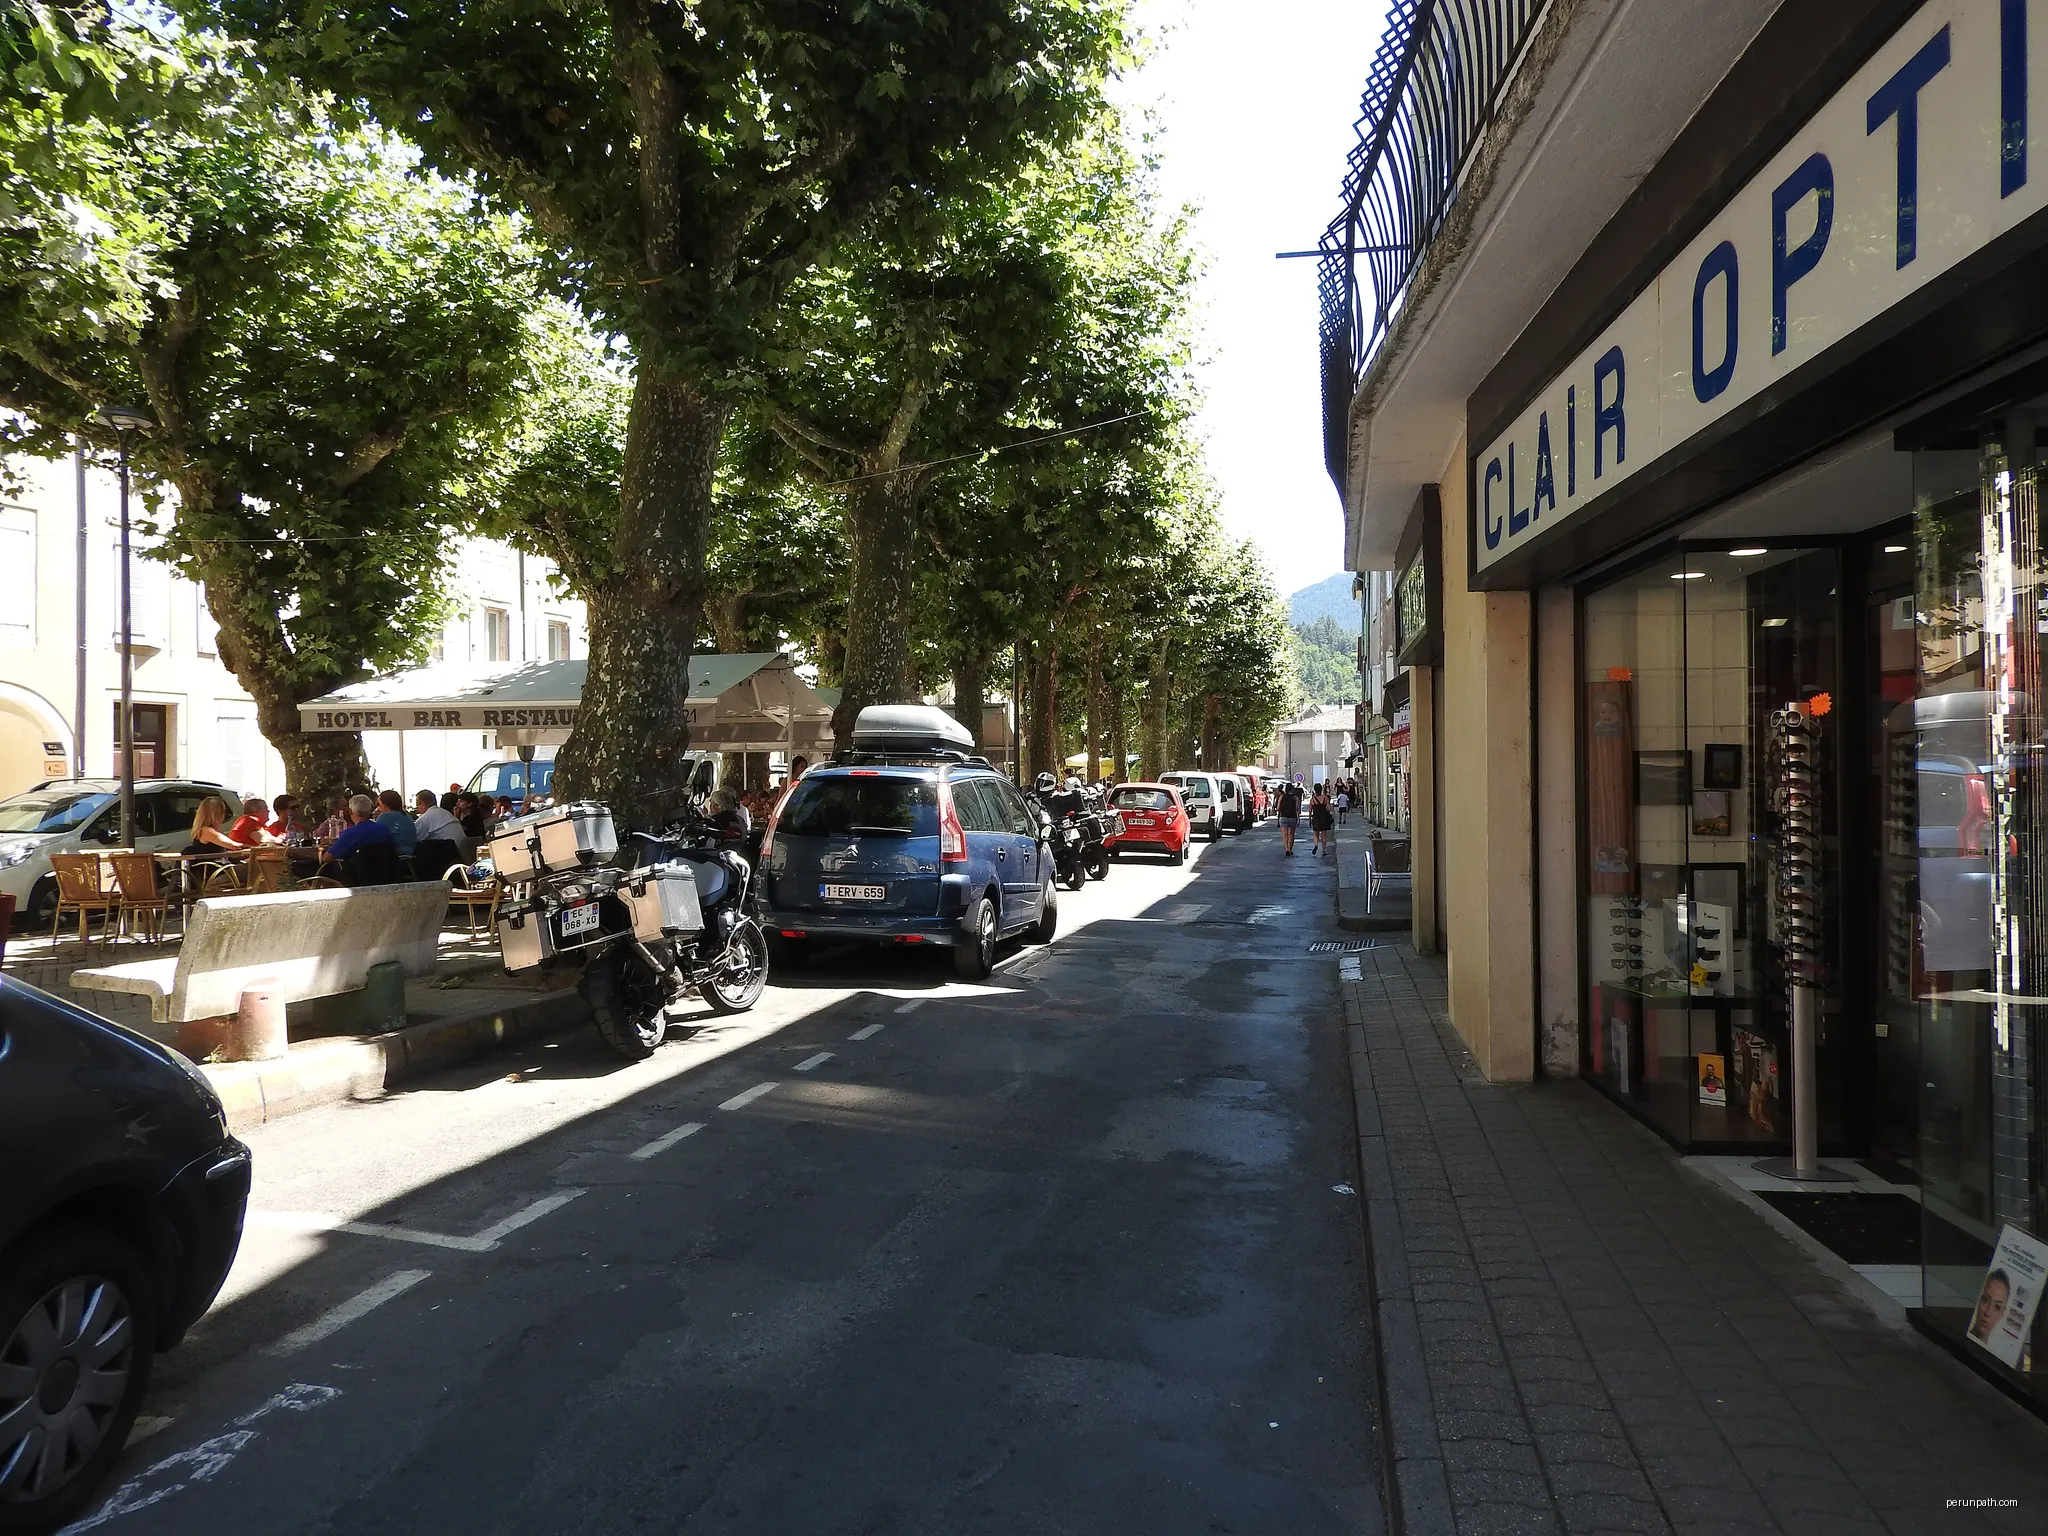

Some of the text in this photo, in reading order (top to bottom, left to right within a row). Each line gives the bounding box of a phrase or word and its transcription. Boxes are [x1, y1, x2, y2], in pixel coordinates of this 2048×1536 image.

[1483, 0, 2028, 550] CLAIR OPTI
[317, 711, 392, 728] HOTEL
[413, 711, 462, 727] BAR
